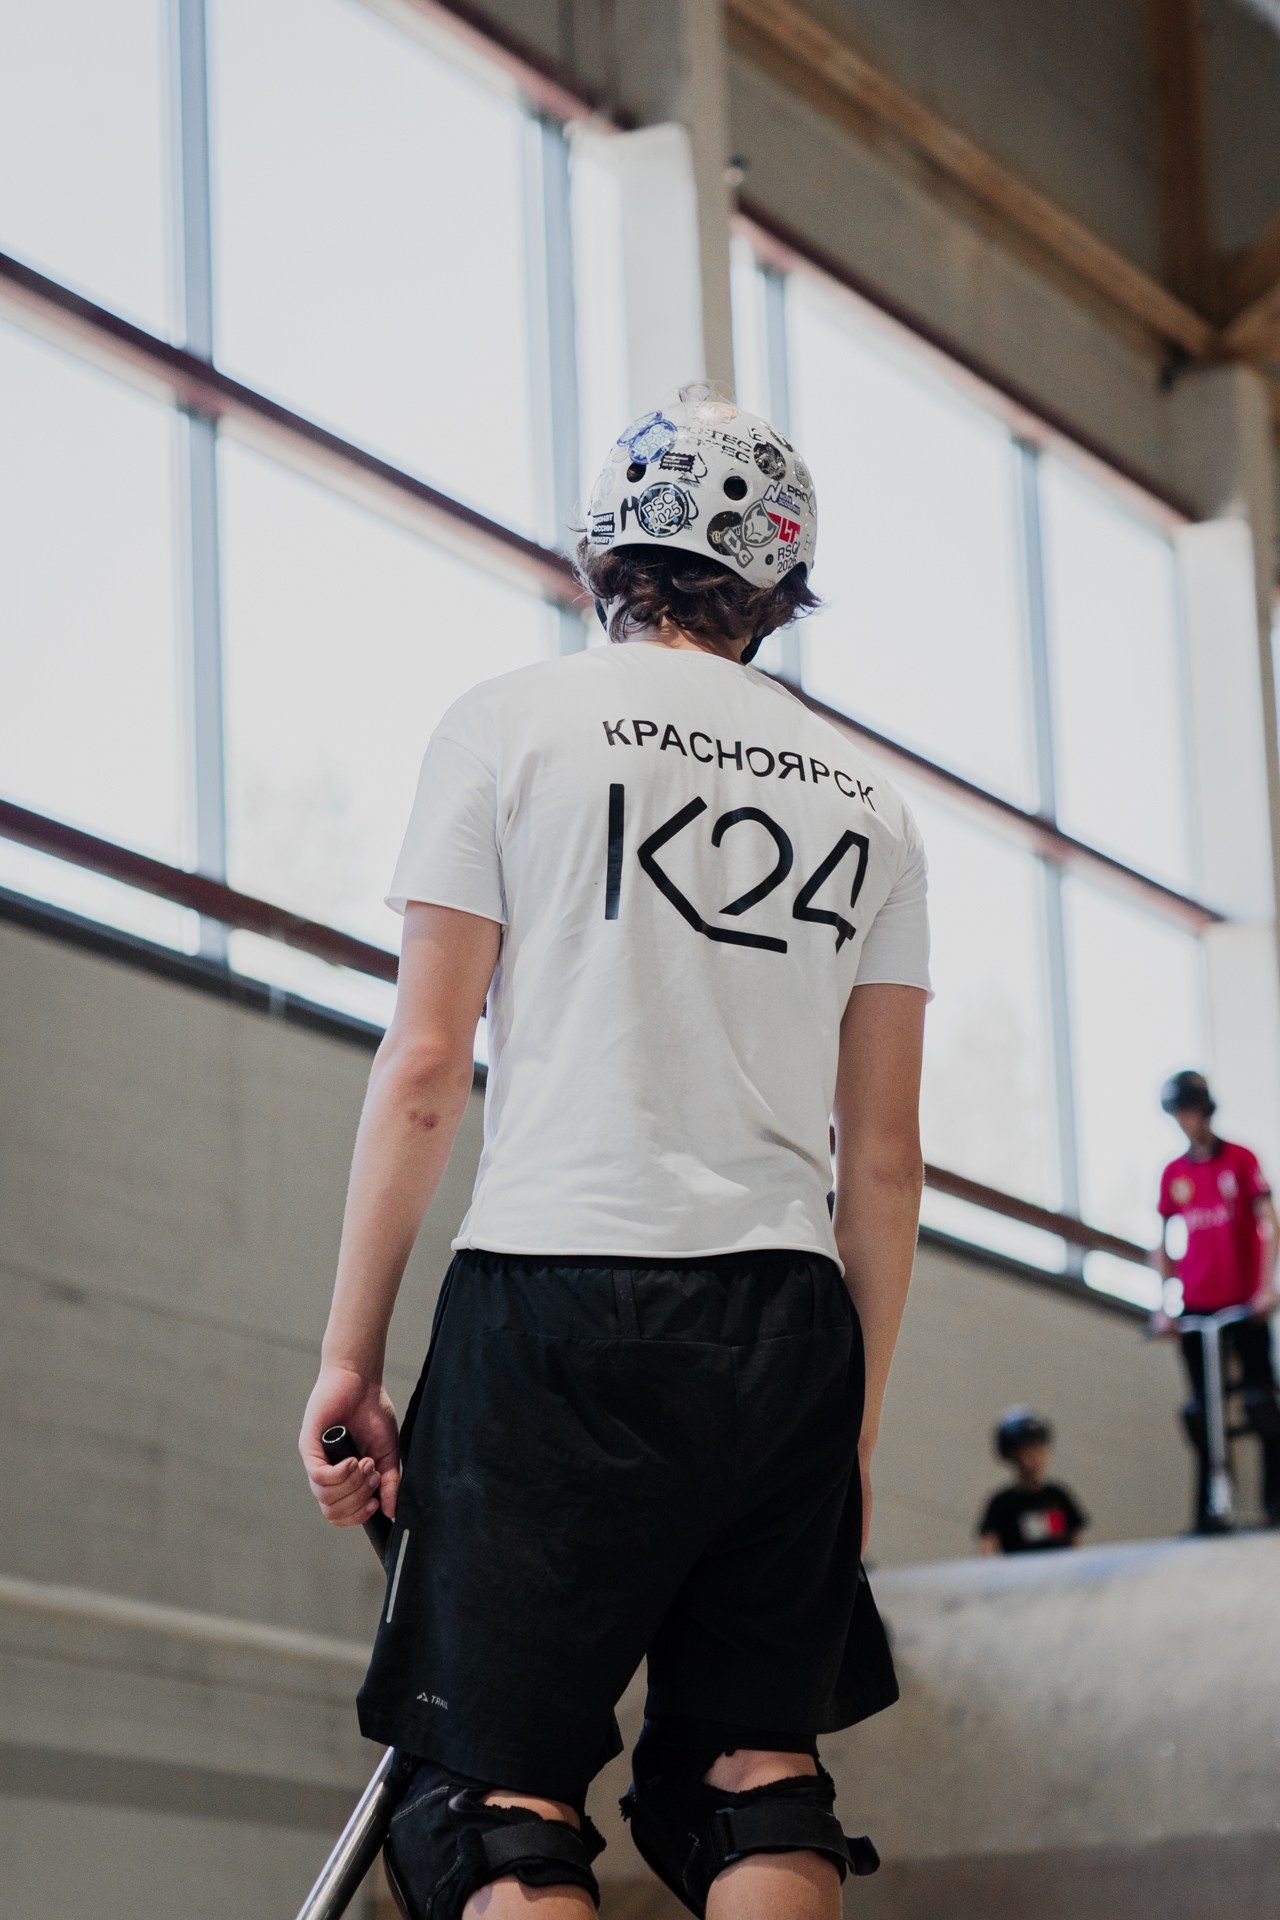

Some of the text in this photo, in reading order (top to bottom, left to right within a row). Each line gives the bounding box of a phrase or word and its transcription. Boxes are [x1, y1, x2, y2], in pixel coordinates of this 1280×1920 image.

[643, 491, 676, 518] RSC
[602, 718, 877, 813] КРАСНОЯРСК
[430, 1694, 449, 1710] TRAIL
